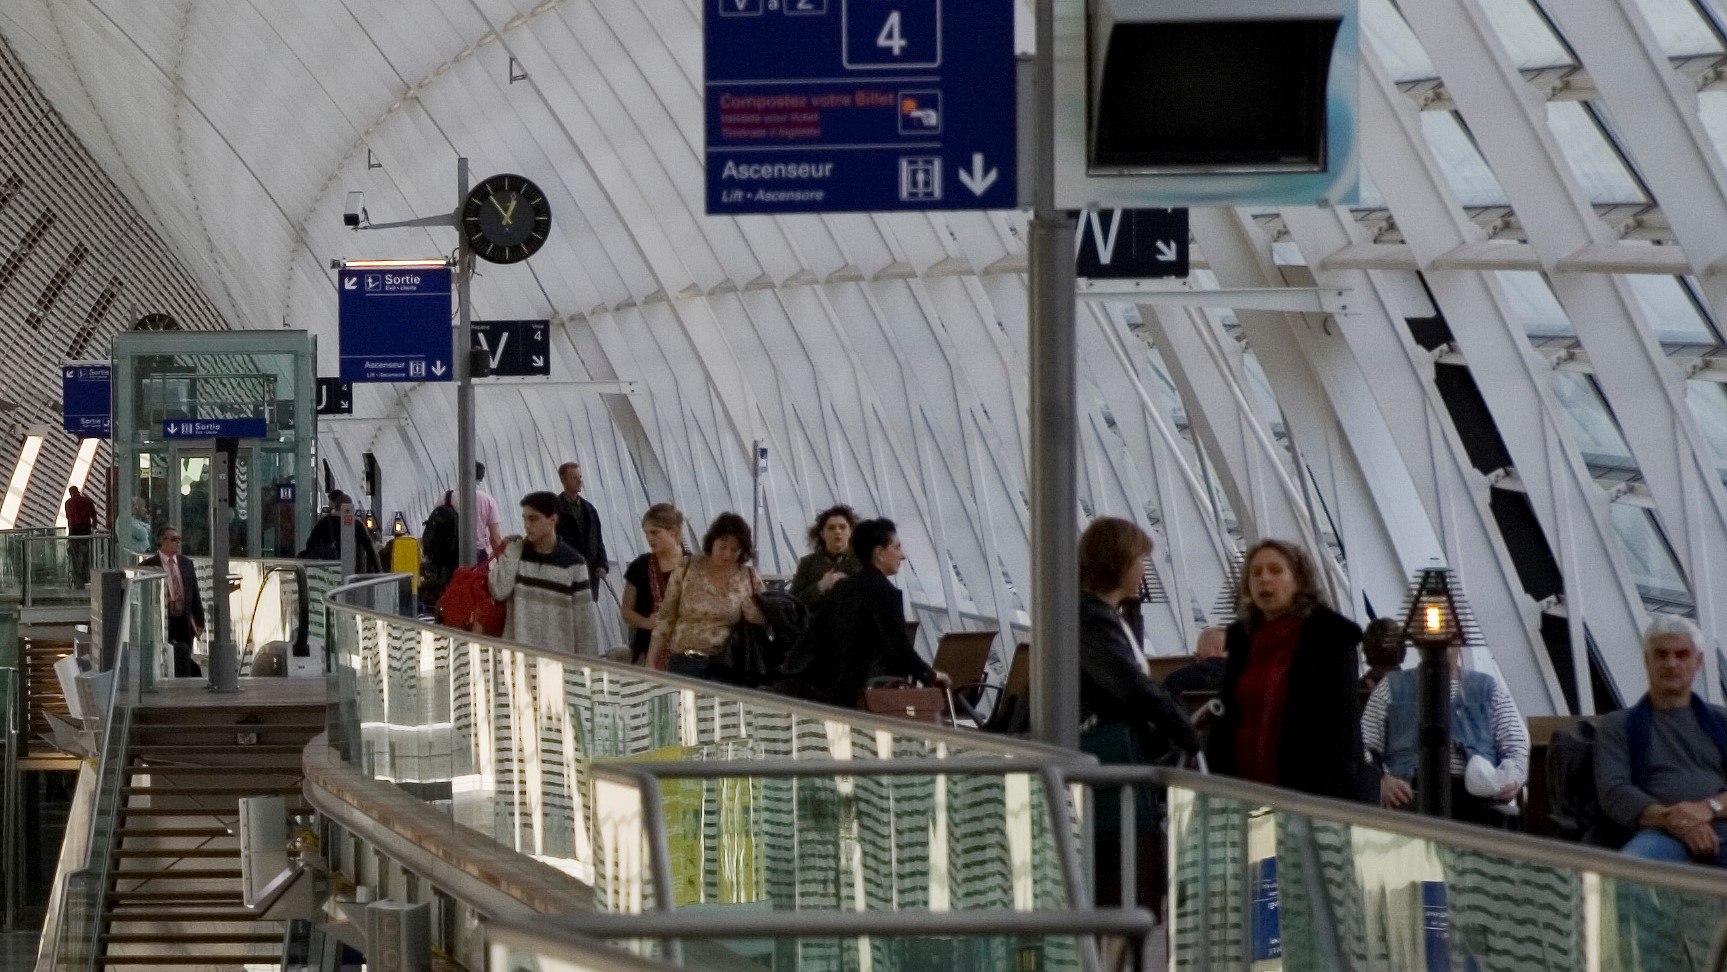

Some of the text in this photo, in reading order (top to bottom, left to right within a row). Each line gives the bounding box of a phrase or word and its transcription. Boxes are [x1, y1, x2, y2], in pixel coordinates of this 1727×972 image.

[876, 10, 908, 56] 4
[722, 159, 834, 179] Ascenseur
[722, 189, 826, 202] Lift Ascensore
[385, 274, 421, 285] Sortie
[534, 331, 543, 341] 4
[477, 332, 509, 369] V
[364, 361, 405, 369] Ascenseur
[195, 422, 221, 431] Sortie
